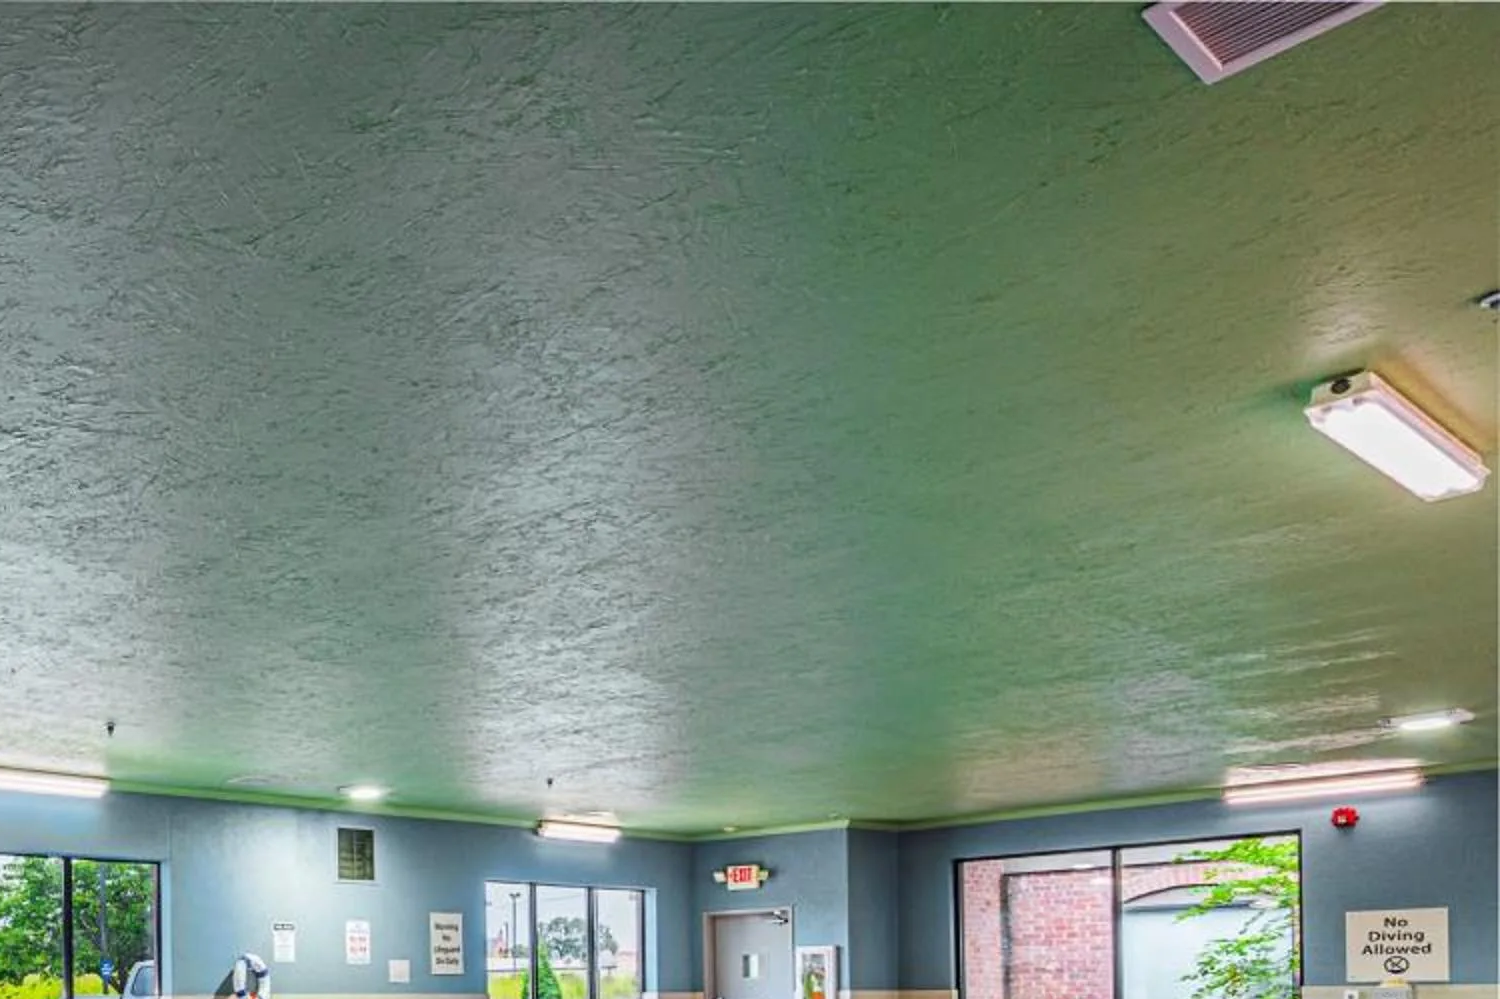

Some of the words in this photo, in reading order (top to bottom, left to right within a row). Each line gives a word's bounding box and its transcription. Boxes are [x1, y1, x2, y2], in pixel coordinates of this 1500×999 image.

[1383, 917, 1408, 927] No
[1368, 930, 1425, 942] Diving
[1362, 943, 1432, 955] Allowed
